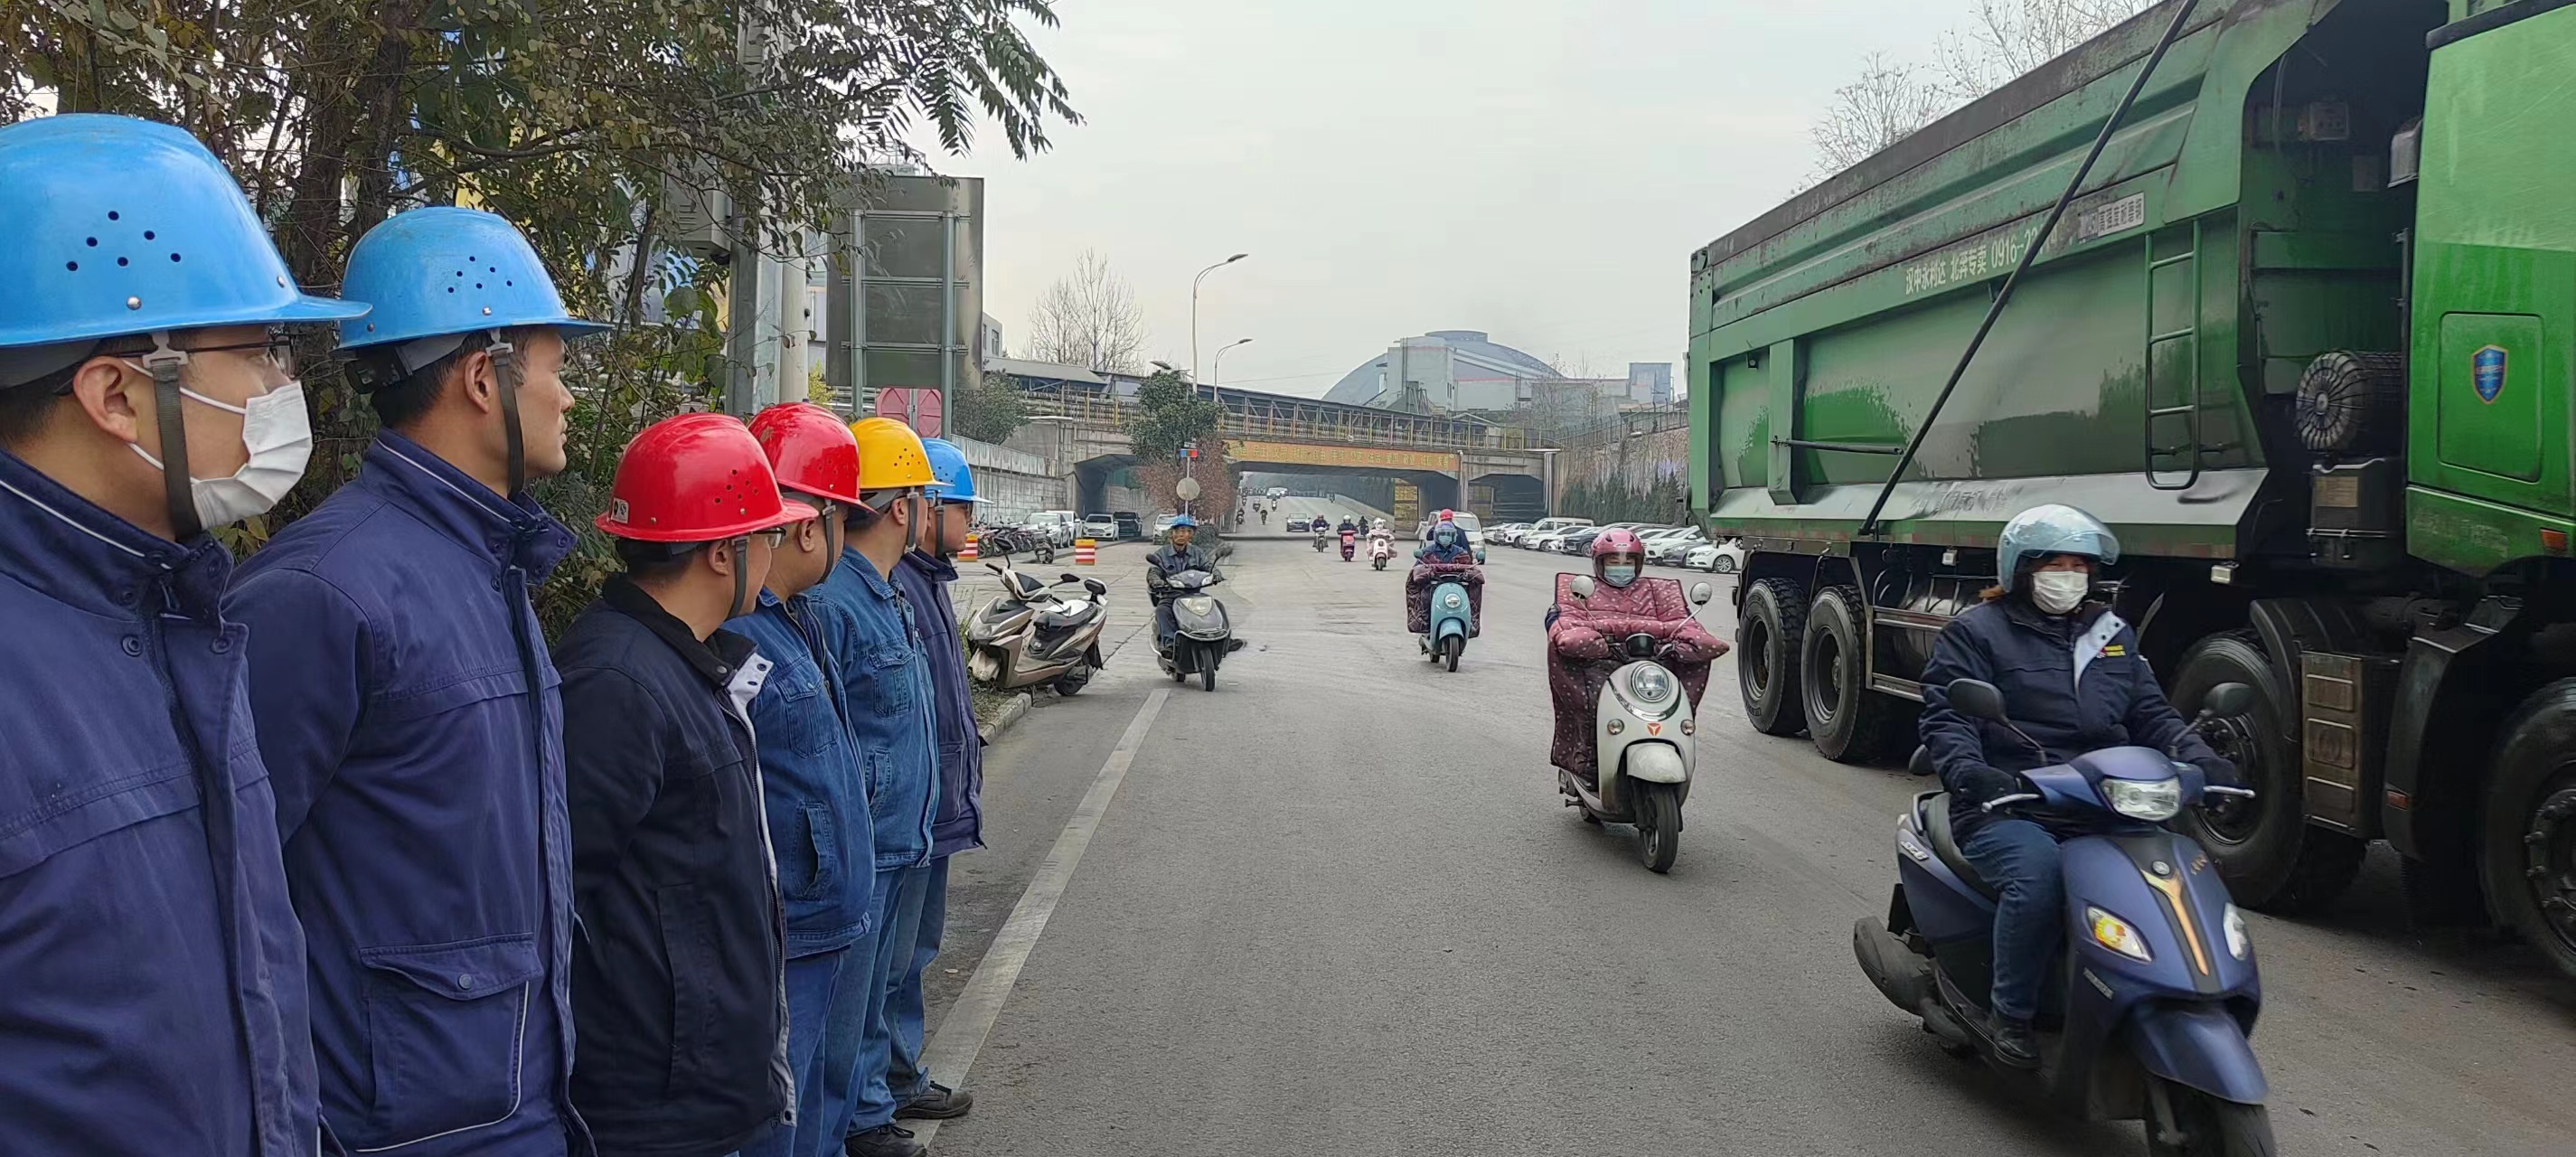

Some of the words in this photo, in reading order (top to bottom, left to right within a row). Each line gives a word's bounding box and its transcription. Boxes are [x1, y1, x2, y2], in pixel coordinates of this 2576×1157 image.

[1905, 257, 1946, 296] 汉中永利达
[1951, 244, 1987, 282] 北奔专卖
